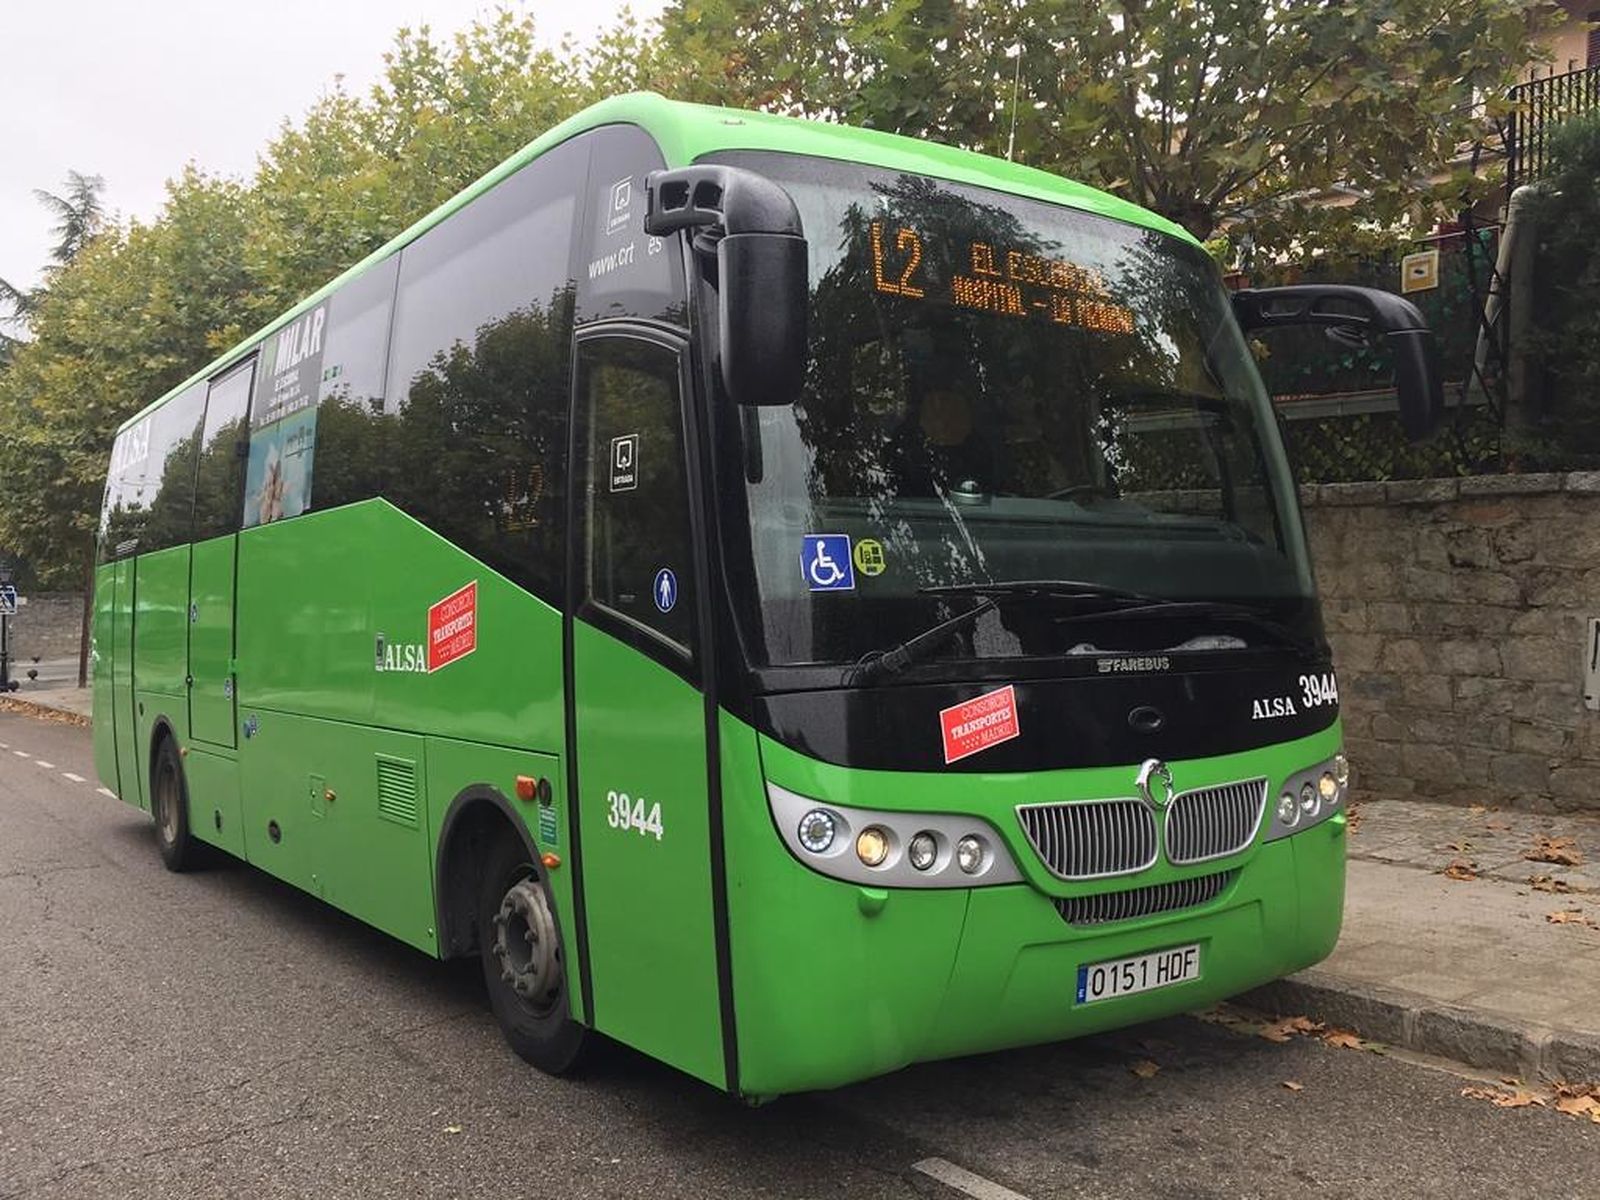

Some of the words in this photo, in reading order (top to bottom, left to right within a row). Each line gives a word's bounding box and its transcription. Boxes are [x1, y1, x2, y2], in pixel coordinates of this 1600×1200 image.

[872, 221, 924, 298] L2
[972, 242, 1001, 276] EL
[274, 306, 326, 377] MILAR
[384, 644, 428, 673] ALSA
[1113, 656, 1170, 672] FAREBUS
[961, 691, 1011, 721] CONSORCIO
[1252, 696, 1297, 720] ALSA
[1299, 672, 1339, 708] 3944
[951, 706, 1013, 741] TRANSPORTES
[981, 721, 1014, 743] MADRID
[607, 791, 664, 840] 3944
[1091, 960, 1148, 997] 0151
[1156, 948, 1197, 984] HDF
